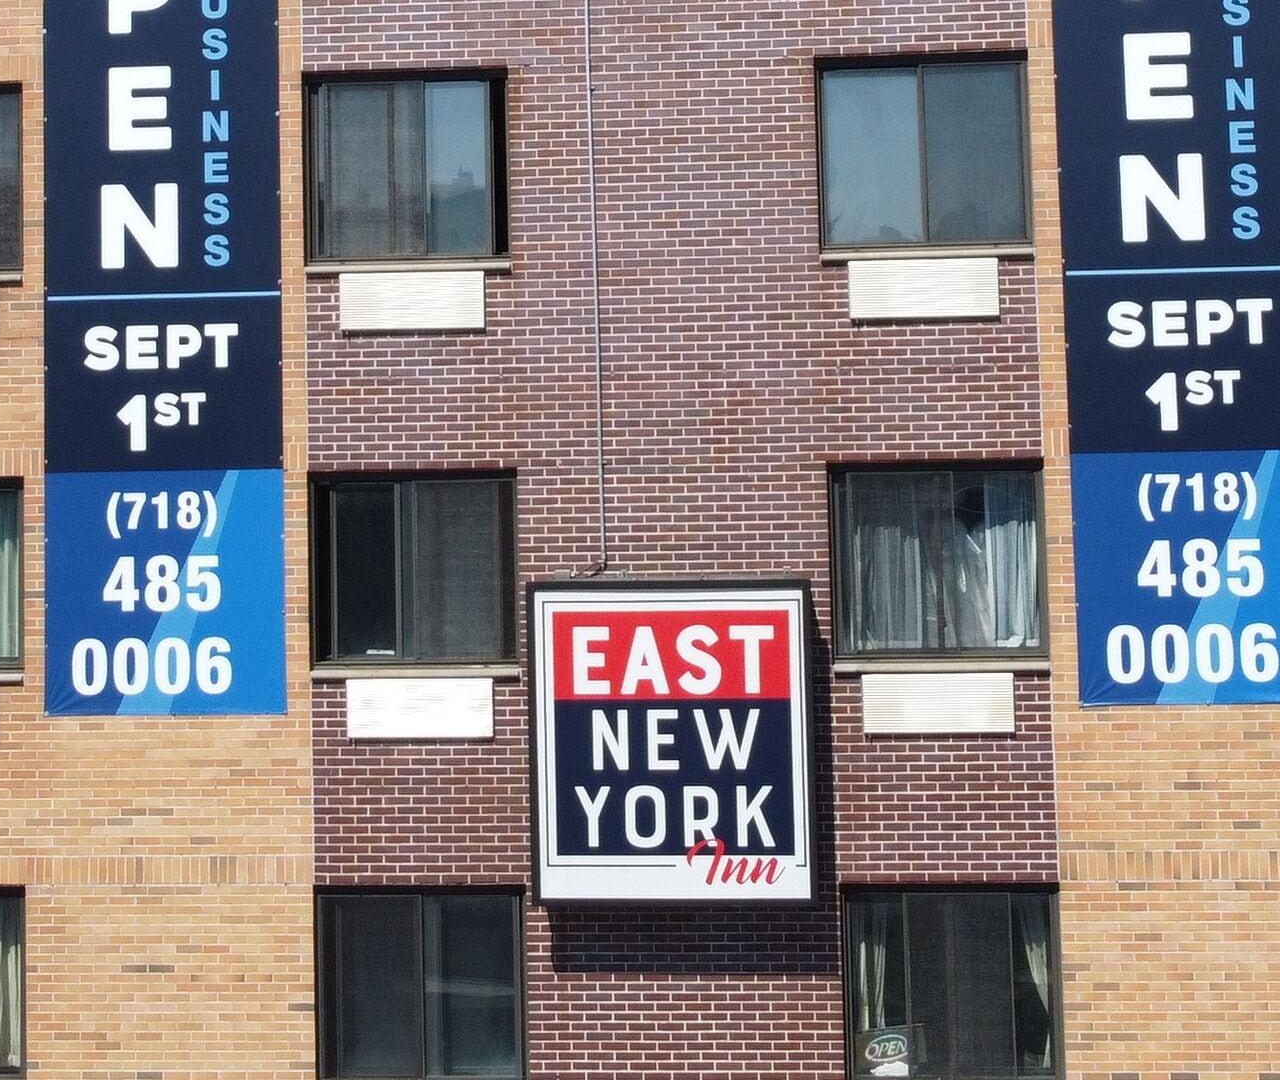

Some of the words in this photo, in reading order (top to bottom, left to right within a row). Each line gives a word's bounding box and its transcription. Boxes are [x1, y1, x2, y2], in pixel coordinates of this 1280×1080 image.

[83, 323, 239, 371] SEPT
[1107, 298, 1273, 348] SEPT
[116, 392, 206, 451] 1ST
[1145, 370, 1240, 431] 1ST
[106, 491, 217, 538] (718)
[1138, 472, 1257, 521] (718)
[103, 555, 220, 612] 485
[1137, 539, 1264, 598] 485
[71, 637, 232, 696] 0006
[572, 624, 774, 695] EAST
[1106, 623, 1279, 684] 0006
[592, 708, 760, 770] NEW
[574, 785, 776, 848] YORK
[686, 838, 785, 885] Inn
[867, 1040, 907, 1058] OPEN
